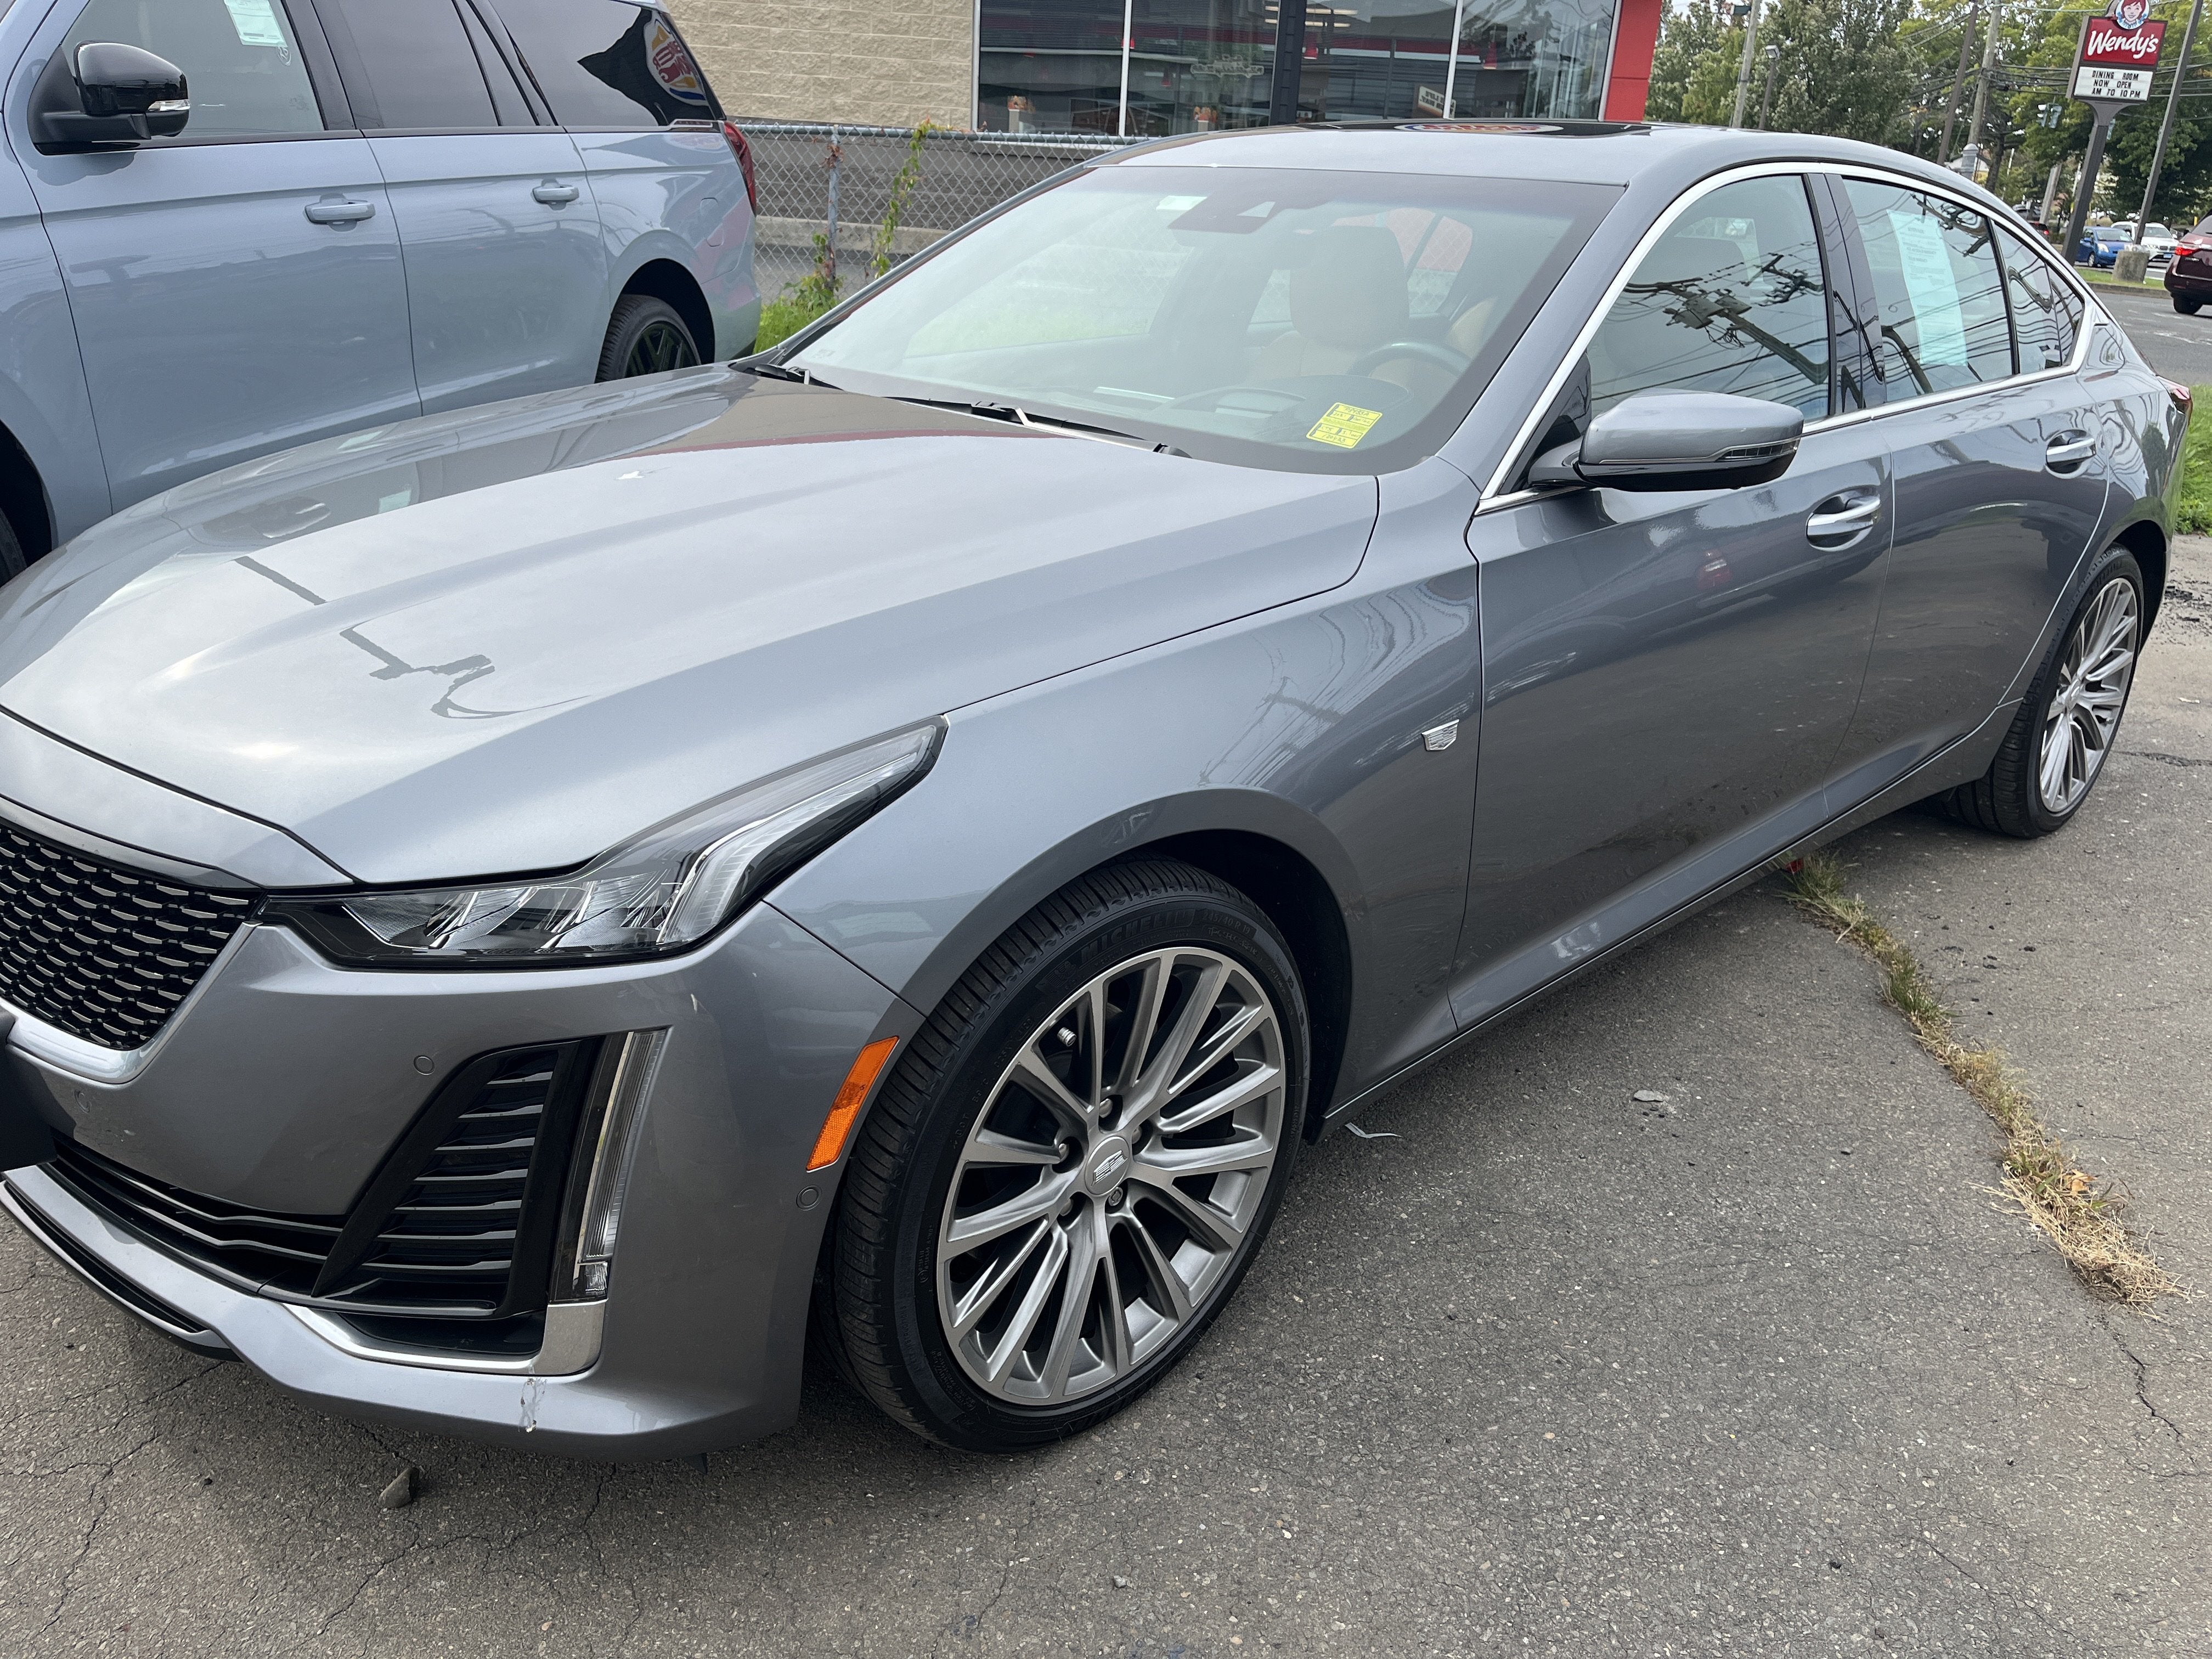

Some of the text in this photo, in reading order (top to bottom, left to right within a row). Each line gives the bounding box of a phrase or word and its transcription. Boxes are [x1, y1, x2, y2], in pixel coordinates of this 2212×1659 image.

[2087, 28, 2159, 59] Wendy's
[2092, 70, 2139, 81] DINING ROOM
[2094, 79, 2132, 89] NOW OPEN
[1081, 910, 1188, 963] MICHELIN
